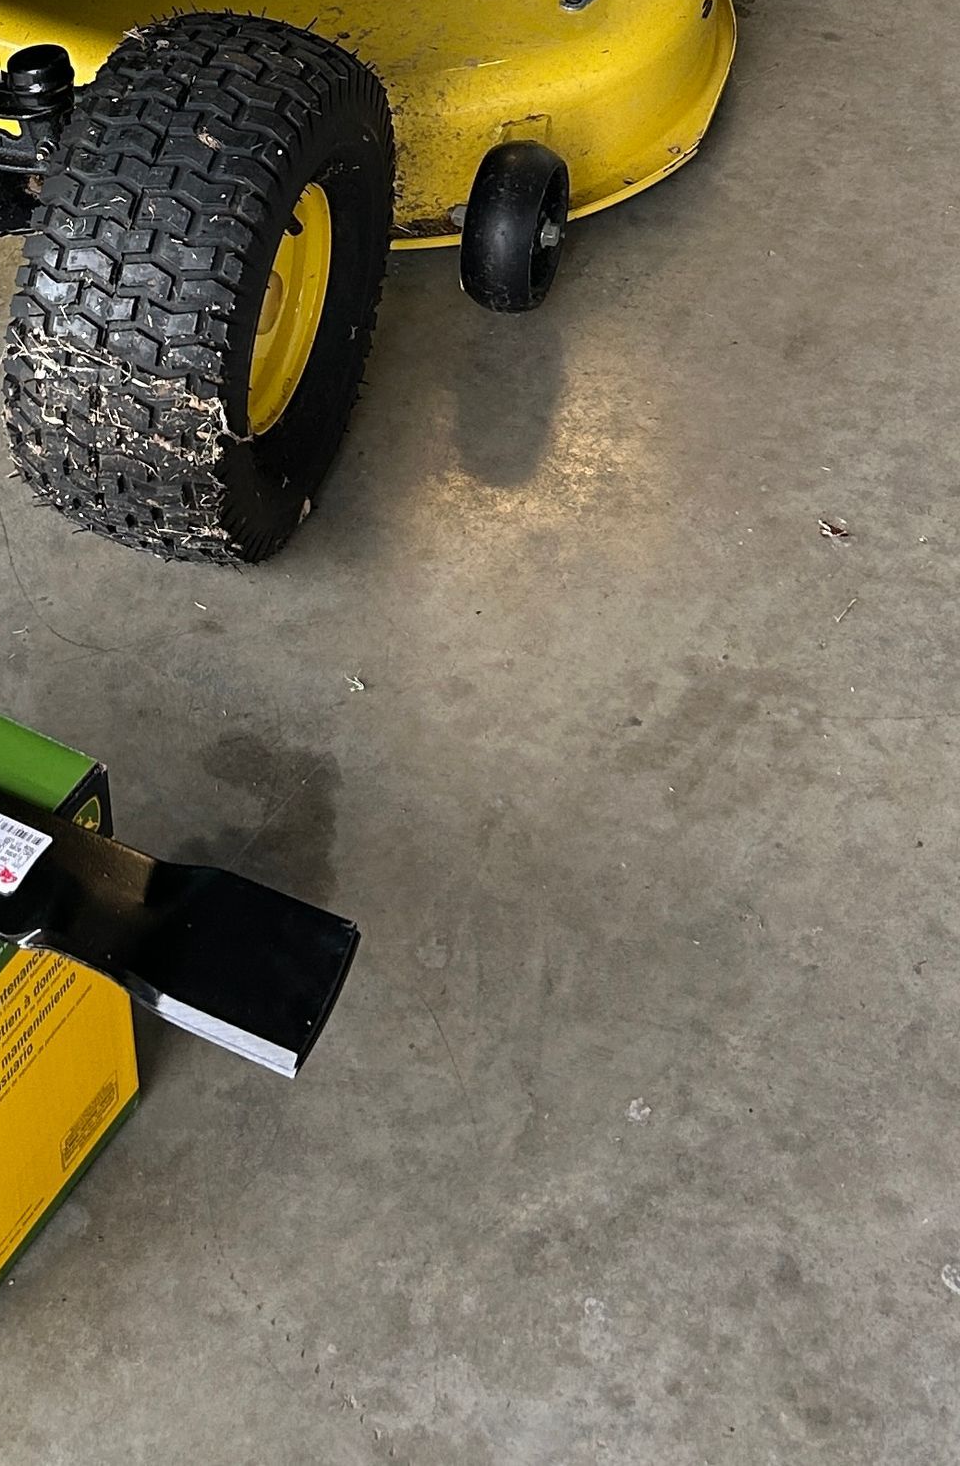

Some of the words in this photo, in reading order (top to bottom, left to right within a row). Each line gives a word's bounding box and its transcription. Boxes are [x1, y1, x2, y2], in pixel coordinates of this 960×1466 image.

[1, 970, 77, 1071] mantenimiento
[23, 993, 32, 1010] à
[33, 956, 66, 997] domic
